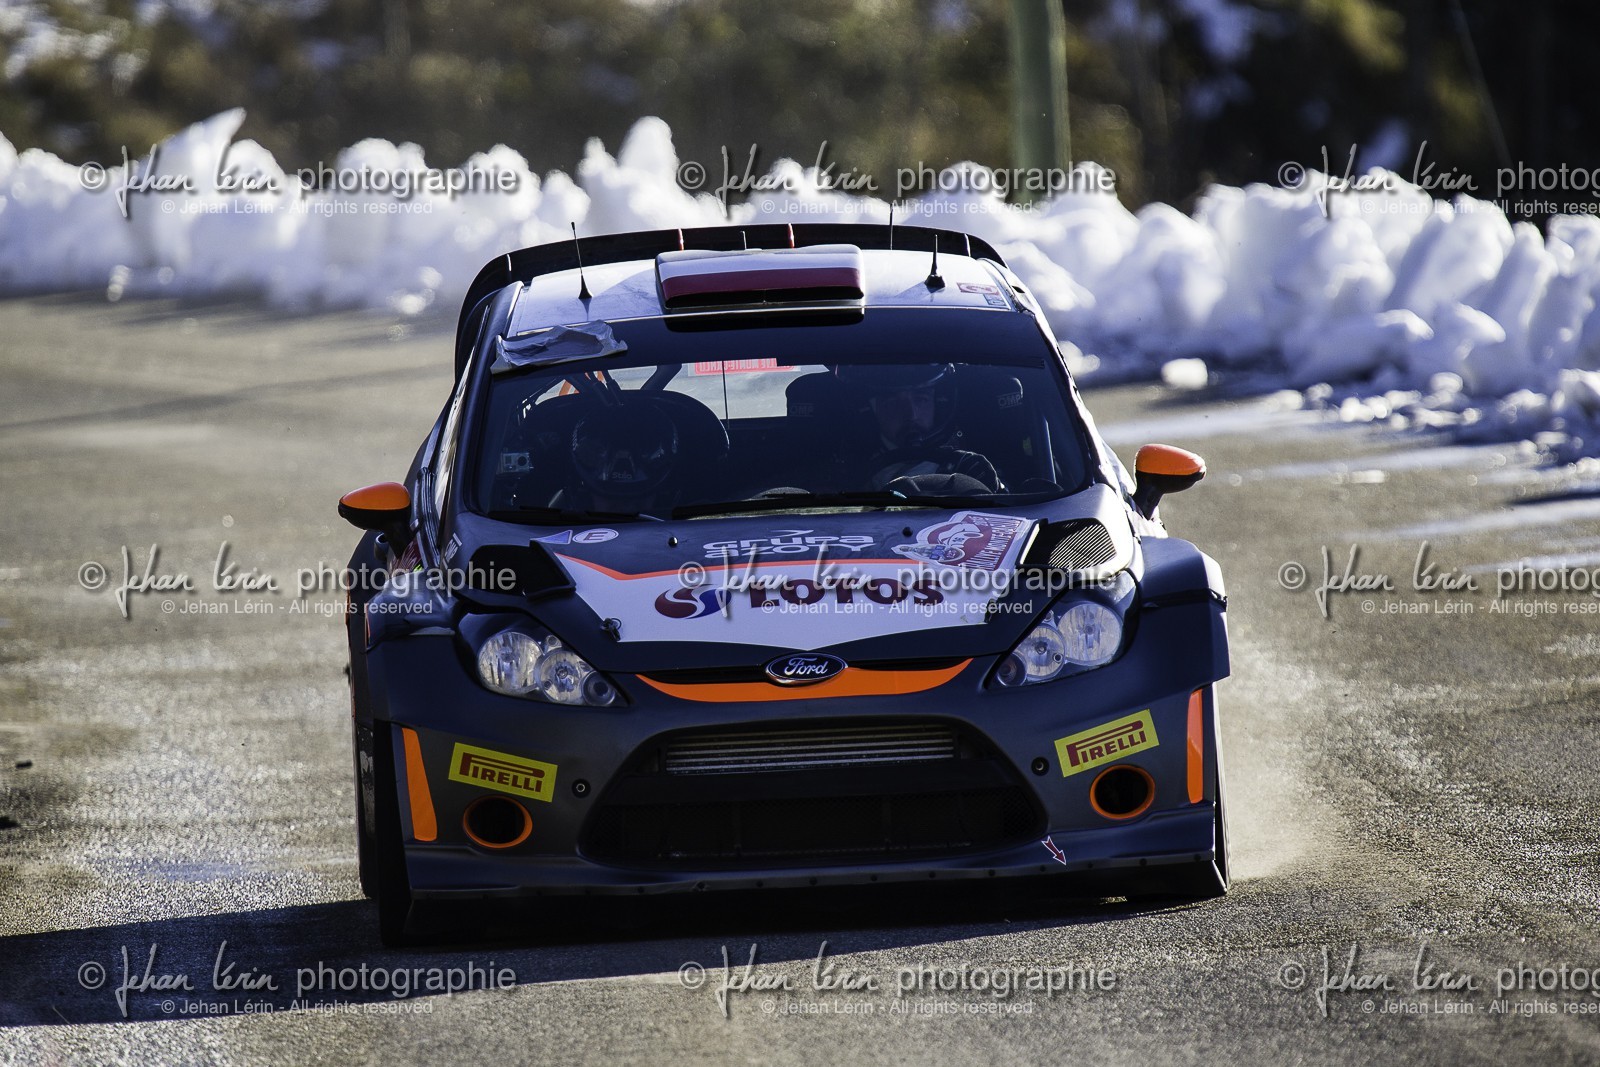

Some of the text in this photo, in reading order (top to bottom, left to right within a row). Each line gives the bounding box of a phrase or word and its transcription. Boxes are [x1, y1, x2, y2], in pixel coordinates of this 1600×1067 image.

[749, 578, 944, 608] LOTOS
[784, 657, 828, 676] Ford
[1066, 720, 1146, 768] PIRELLI
[459, 752, 545, 792] PIRELLI
